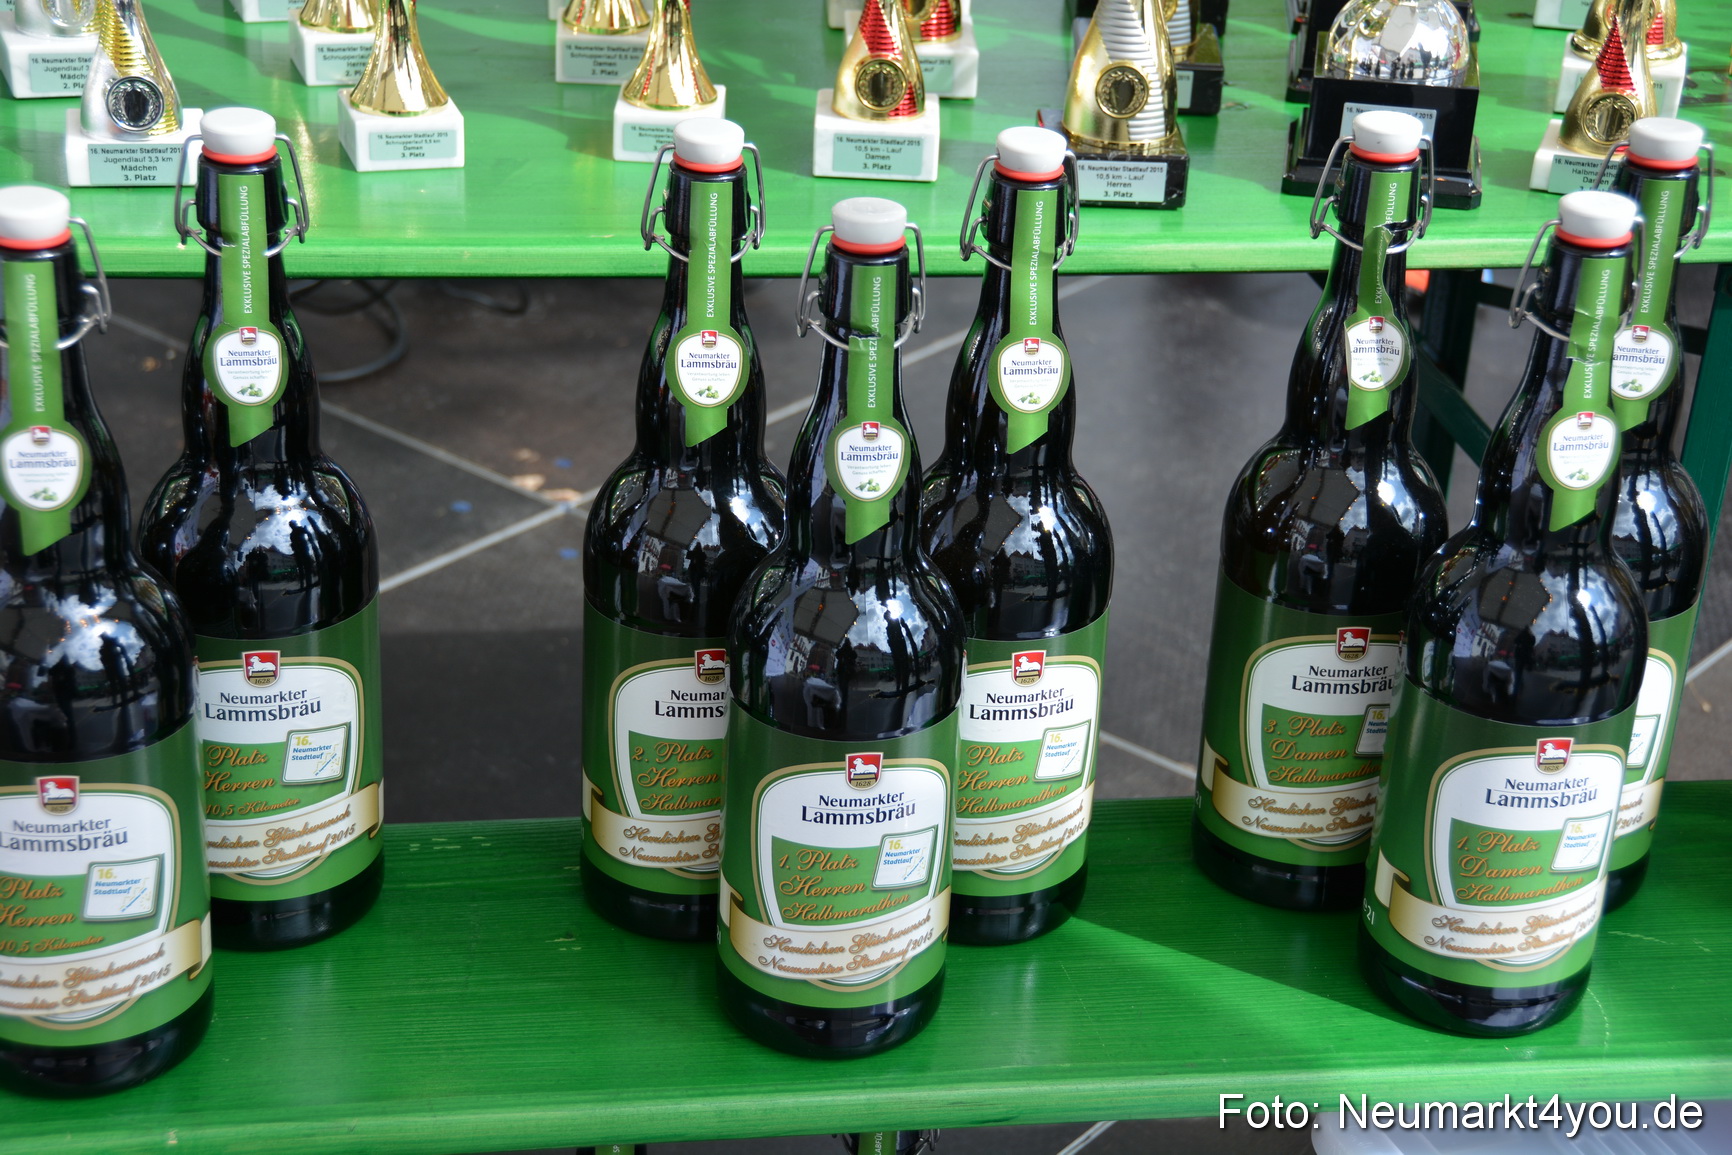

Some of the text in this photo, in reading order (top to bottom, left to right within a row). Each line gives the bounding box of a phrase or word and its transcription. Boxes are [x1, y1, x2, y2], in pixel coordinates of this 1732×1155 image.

[1564, 160, 1599, 168] Neumarkter
[238, 185, 252, 314] EXKLUSIVE SPEZIALABFÜLLUNG
[706, 192, 718, 318] EXKLUSIVE SPEZIALABFÜLLUNG
[1640, 190, 1670, 313] EXKLUSIVE SPEZIALABFÜLLUNG
[1029, 201, 1044, 326] EXKLUSIVE SPEZIALABFÜLLUNG
[1584, 269, 1610, 398] EXKLUSIVE SPEZIALABFÜLLUNG
[1351, 345, 1400, 356] ammsbräu
[1613, 353, 1665, 364] ammsbräu
[1616, 346, 1659, 355] Neumarkter
[220, 356, 277, 366] Lammsbräu
[681, 359, 737, 369] Lammsbräu
[1012, 358, 1051, 366] Neumarkter
[1004, 365, 1058, 375] Lammsbräu
[35, 364, 45, 412] EXKLUSIVE
[868, 363, 876, 408] EXKLUSIVE
[1553, 440, 1609, 452] Lammsbräu
[1562, 434, 1603, 442] Neumarkter
[18, 450, 67, 459] Neumarkter
[841, 452, 898, 461] Lammsbräu
[849, 444, 892, 452] Neumarkter
[9, 458, 76, 470] Lammsbräu
[1309, 665, 1388, 678] Neumarkter
[254, 677, 271, 685] 1628
[220, 688, 307, 704] Neumarkter
[986, 687, 1064, 704] Neumarkter
[205, 700, 321, 722] Lammsbräu
[970, 697, 1074, 721] Lammsbräu
[1371, 710, 1385, 720] 16.
[1264, 716, 1346, 737] 3. Platz
[295, 735, 312, 746] 16.
[1046, 741, 1077, 750] Neumarkter
[1050, 734, 1063, 743] 16.
[206, 745, 268, 767] Platz
[291, 752, 324, 761] Stadtlauf
[292, 744, 332, 753] Neumarkter
[632, 742, 713, 763] 2. Platz
[966, 745, 1025, 767] Platz
[1045, 749, 1071, 758] Stadtlauf
[1270, 738, 1347, 761] Damen
[204, 770, 275, 792] Herren
[637, 767, 718, 788] Herren
[958, 770, 1029, 791] Herren
[1504, 776, 1589, 791] Neumarkter
[819, 791, 904, 808] Neumarkter
[956, 784, 1067, 814] Halbmarathon
[1485, 787, 1597, 809] Lammsbräu
[205, 798, 300, 816] 10,5 Kilometer
[802, 803, 916, 826] Lammsbräu
[13, 818, 111, 834] Neumarkter
[330, 824, 357, 845] 2015
[1066, 817, 1084, 839] 2015
[1570, 823, 1583, 833] 16.
[889, 839, 903, 850] 16.
[1457, 831, 1540, 853] 1. Platz
[1563, 840, 1590, 849] Stadtlauf
[1566, 832, 1596, 841] Neumarkter
[779, 849, 858, 872] 1. Platz
[883, 856, 914, 865] Stadtlauf
[885, 848, 921, 857] Neumarkter
[97, 868, 117, 879] 16.
[1458, 854, 1543, 879] Damen
[0, 876, 65, 899] Platz
[95, 878, 141, 887] Neumarkter
[779, 875, 865, 897] Herren
[1456, 875, 1584, 902] Halbmarathon
[94, 887, 131, 896] Stadtlauf
[782, 892, 910, 921] Halbmarathon
[0, 904, 75, 927] Herren
[34, 934, 104, 951] Kilometer
[911, 928, 934, 950] 2015
[140, 963, 171, 988] 2015
